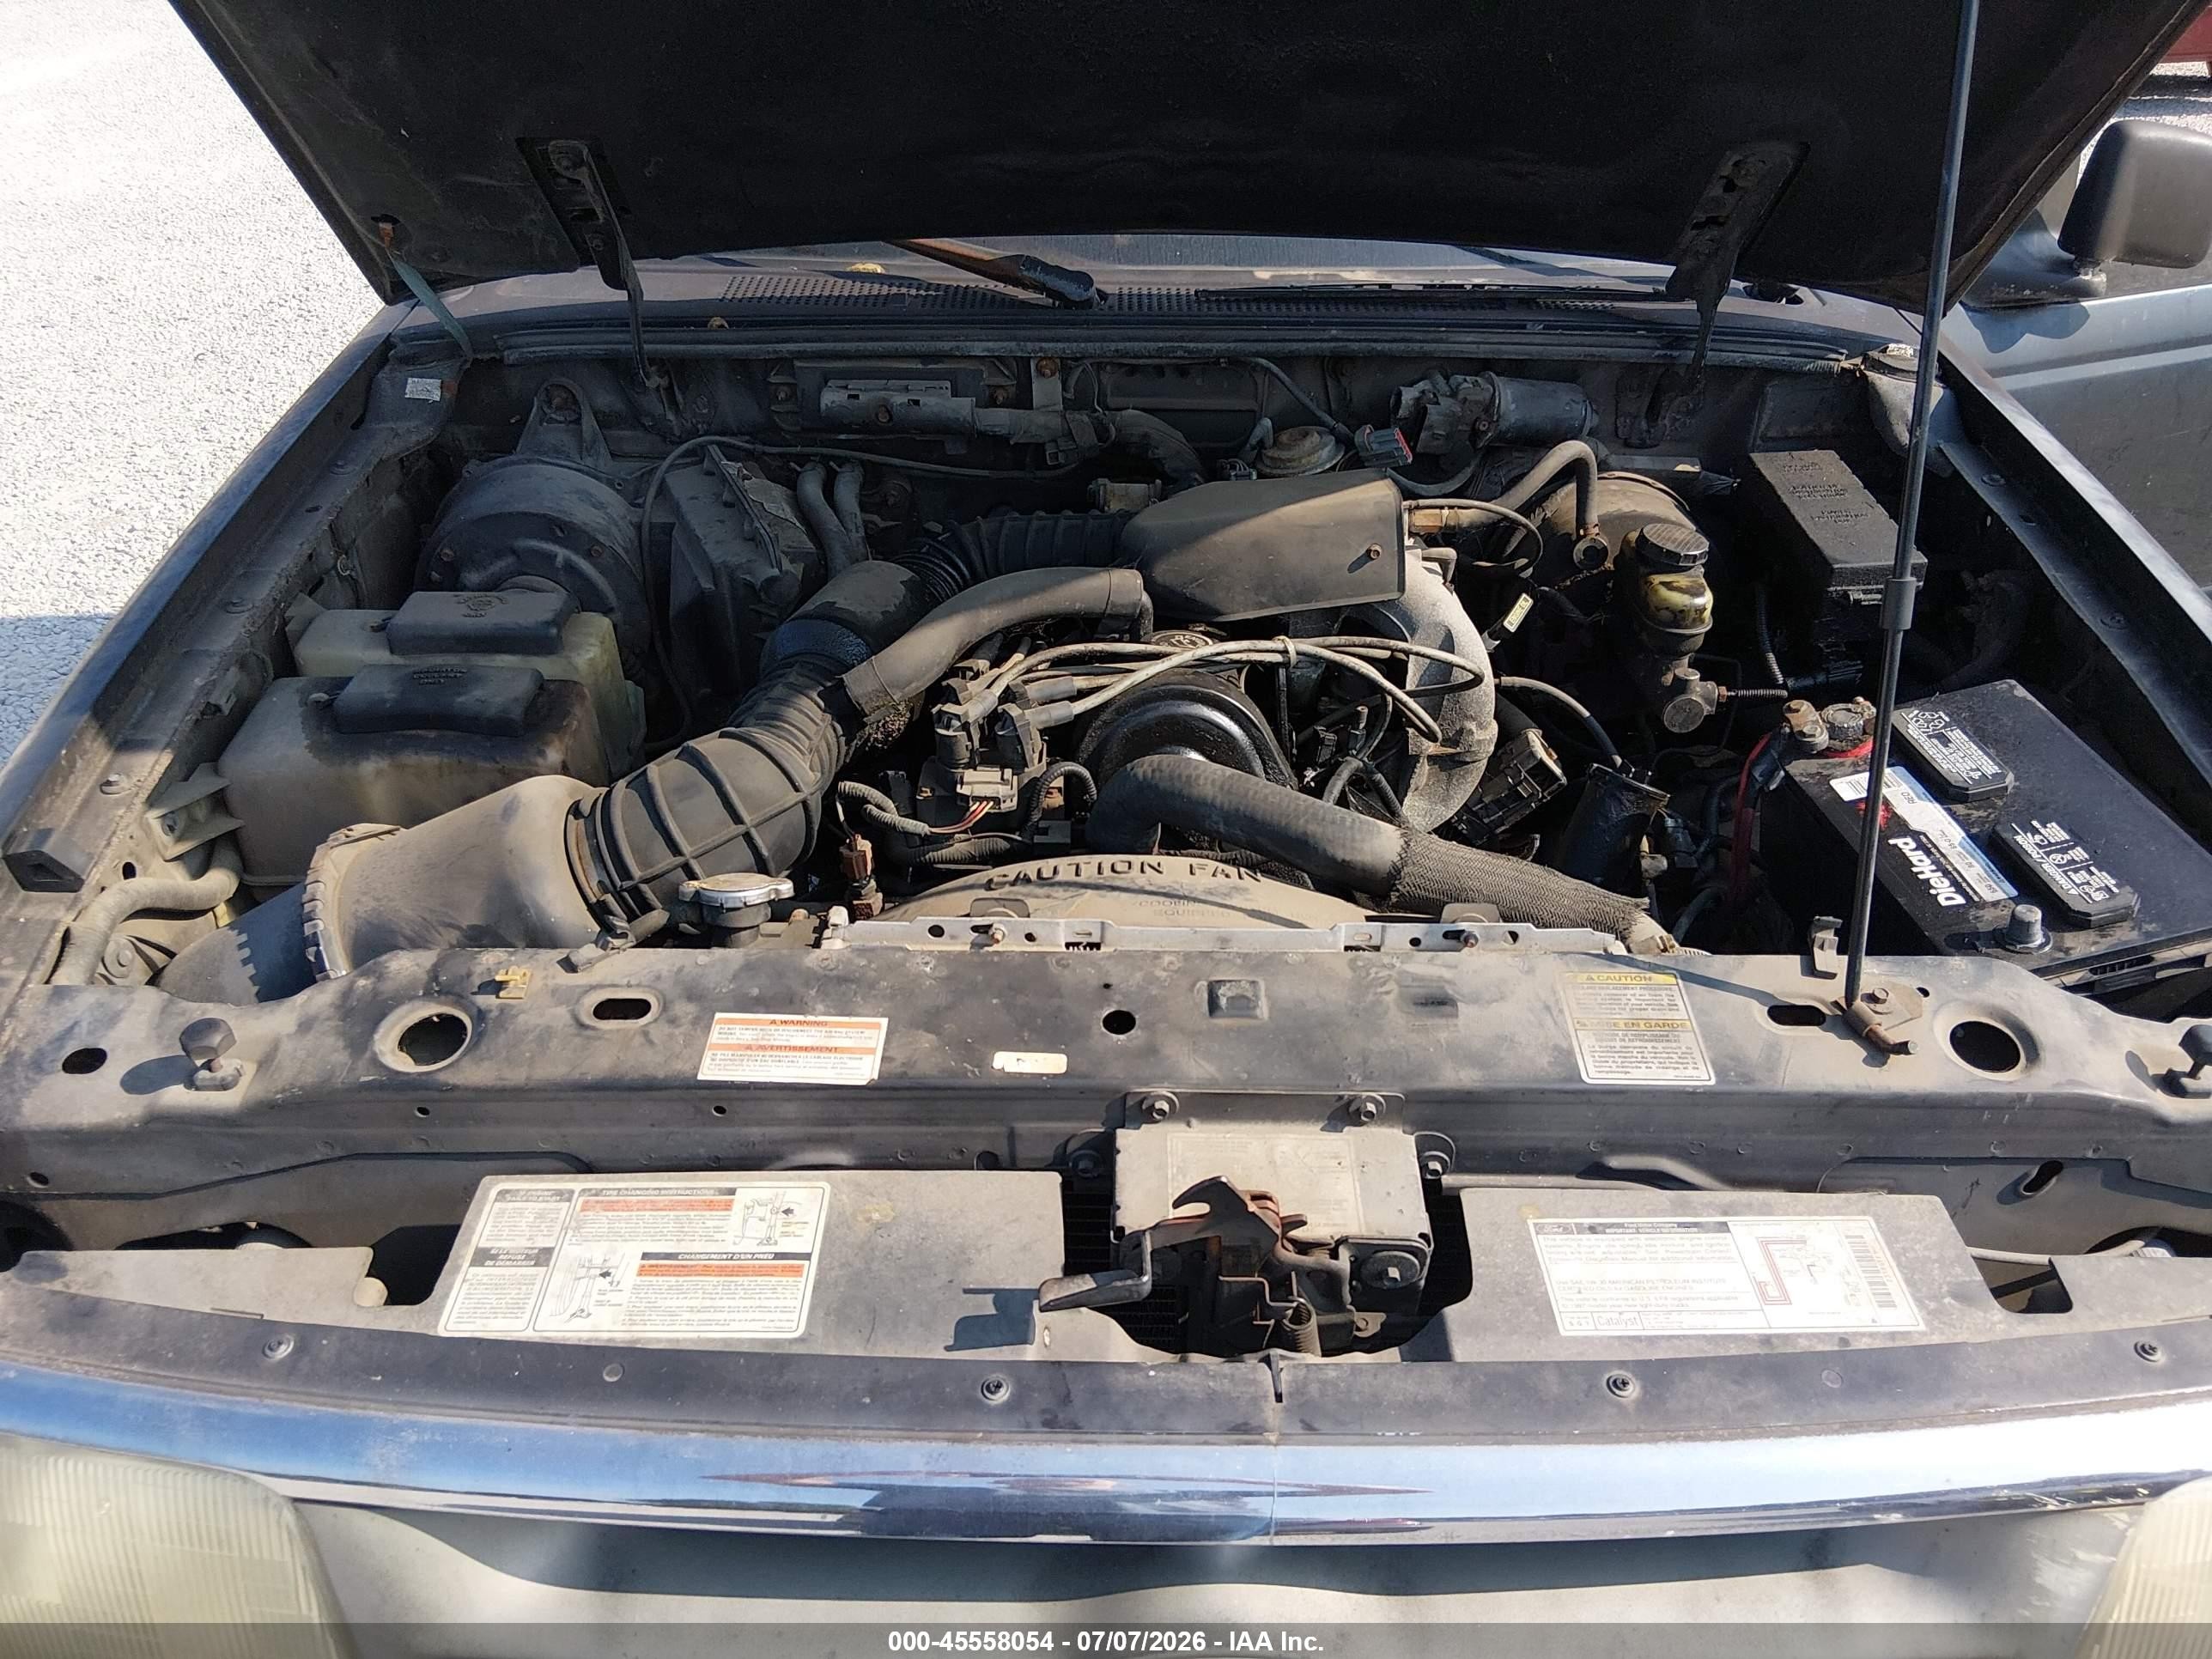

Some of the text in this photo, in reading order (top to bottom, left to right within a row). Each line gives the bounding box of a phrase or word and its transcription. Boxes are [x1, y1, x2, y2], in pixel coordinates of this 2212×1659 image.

[984, 860, 1261, 891] CAUTION FAN
[1887, 837, 1966, 907] DieHard
[756, 1044, 838, 1054] AVERTISSEMENT
[1597, 1316, 1639, 1328] Catalyst
